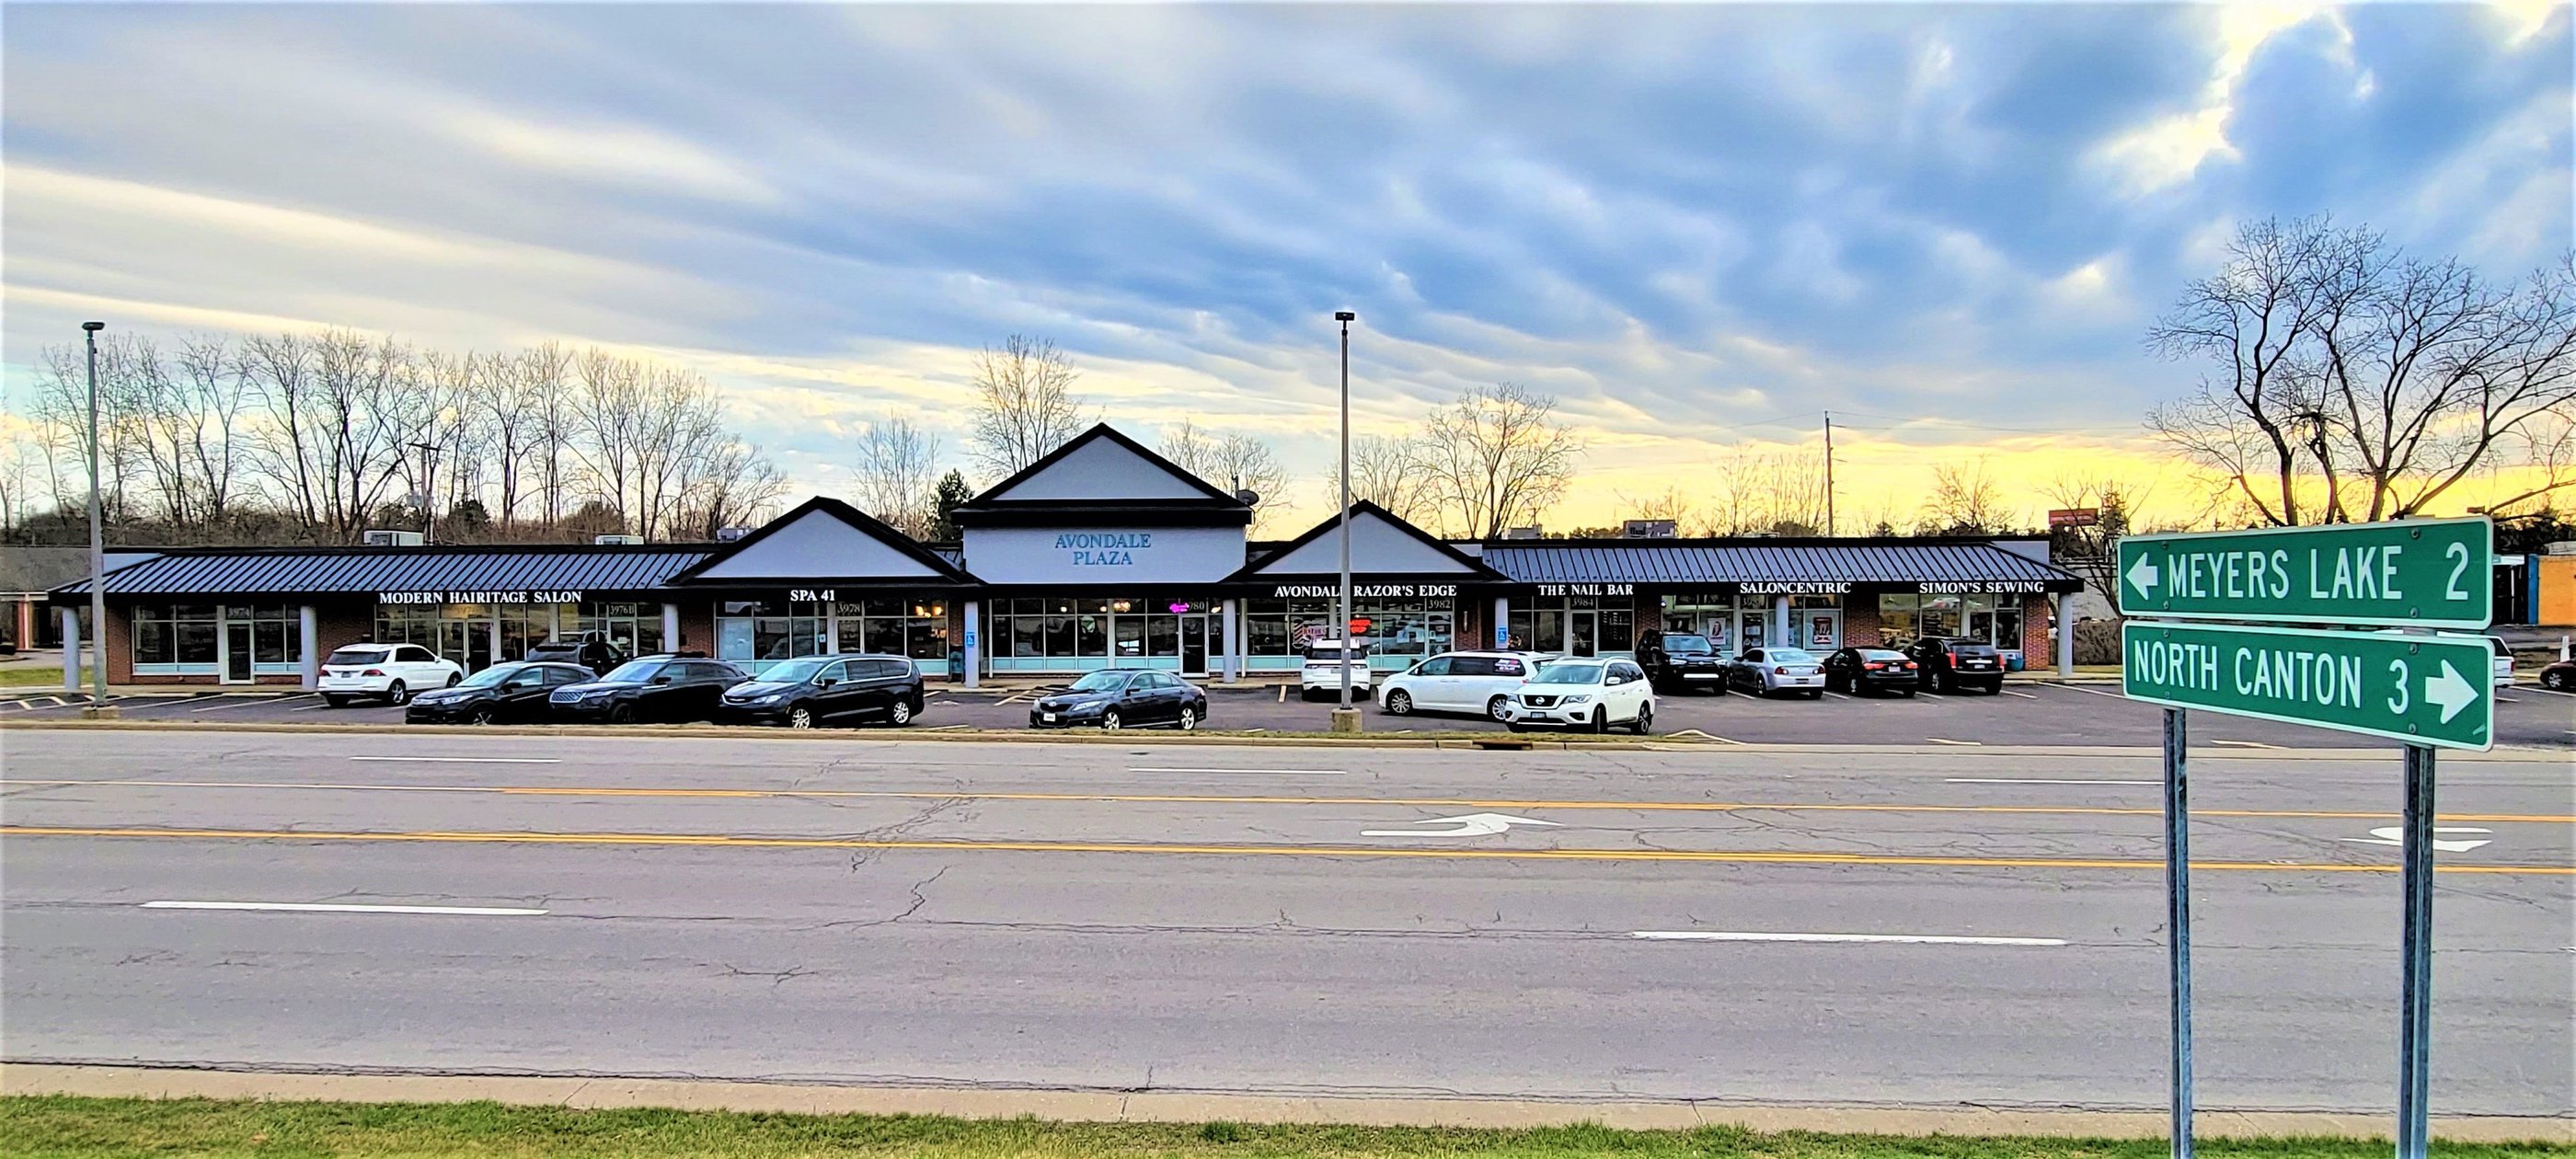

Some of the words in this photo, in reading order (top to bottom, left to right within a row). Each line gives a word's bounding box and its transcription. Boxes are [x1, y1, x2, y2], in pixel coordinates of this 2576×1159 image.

[1055, 534, 1151, 549] AVONDALE
[1073, 551, 1133, 566] PLAZA
[2168, 548, 2290, 600] MEYERS
[2310, 545, 2403, 600] LAKE
[2444, 541, 2469, 601] 2
[1274, 585, 1342, 598] AVONDAL
[1353, 585, 1414, 597] RAZOR'S
[1419, 585, 1457, 597] EDGE
[1537, 584, 1566, 596] THE
[1570, 584, 1602, 596] NAIL
[1607, 584, 1633, 596] BAR
[1740, 581, 1851, 594] SALONCENTRIC
[1919, 581, 1981, 594] SIMON'S
[1985, 581, 2044, 593] SEWING
[379, 591, 443, 603] MODERN
[449, 591, 527, 603] HAIRITAGE
[534, 591, 581, 603] SALON
[789, 590, 817, 602] SPA
[821, 590, 835, 602] 41
[837, 603, 860, 614] 3978
[1428, 599, 1451, 609] 3982
[2134, 639, 2218, 691] NORTH
[2235, 648, 2362, 707] CANTON
[2387, 659, 2409, 715] 3
